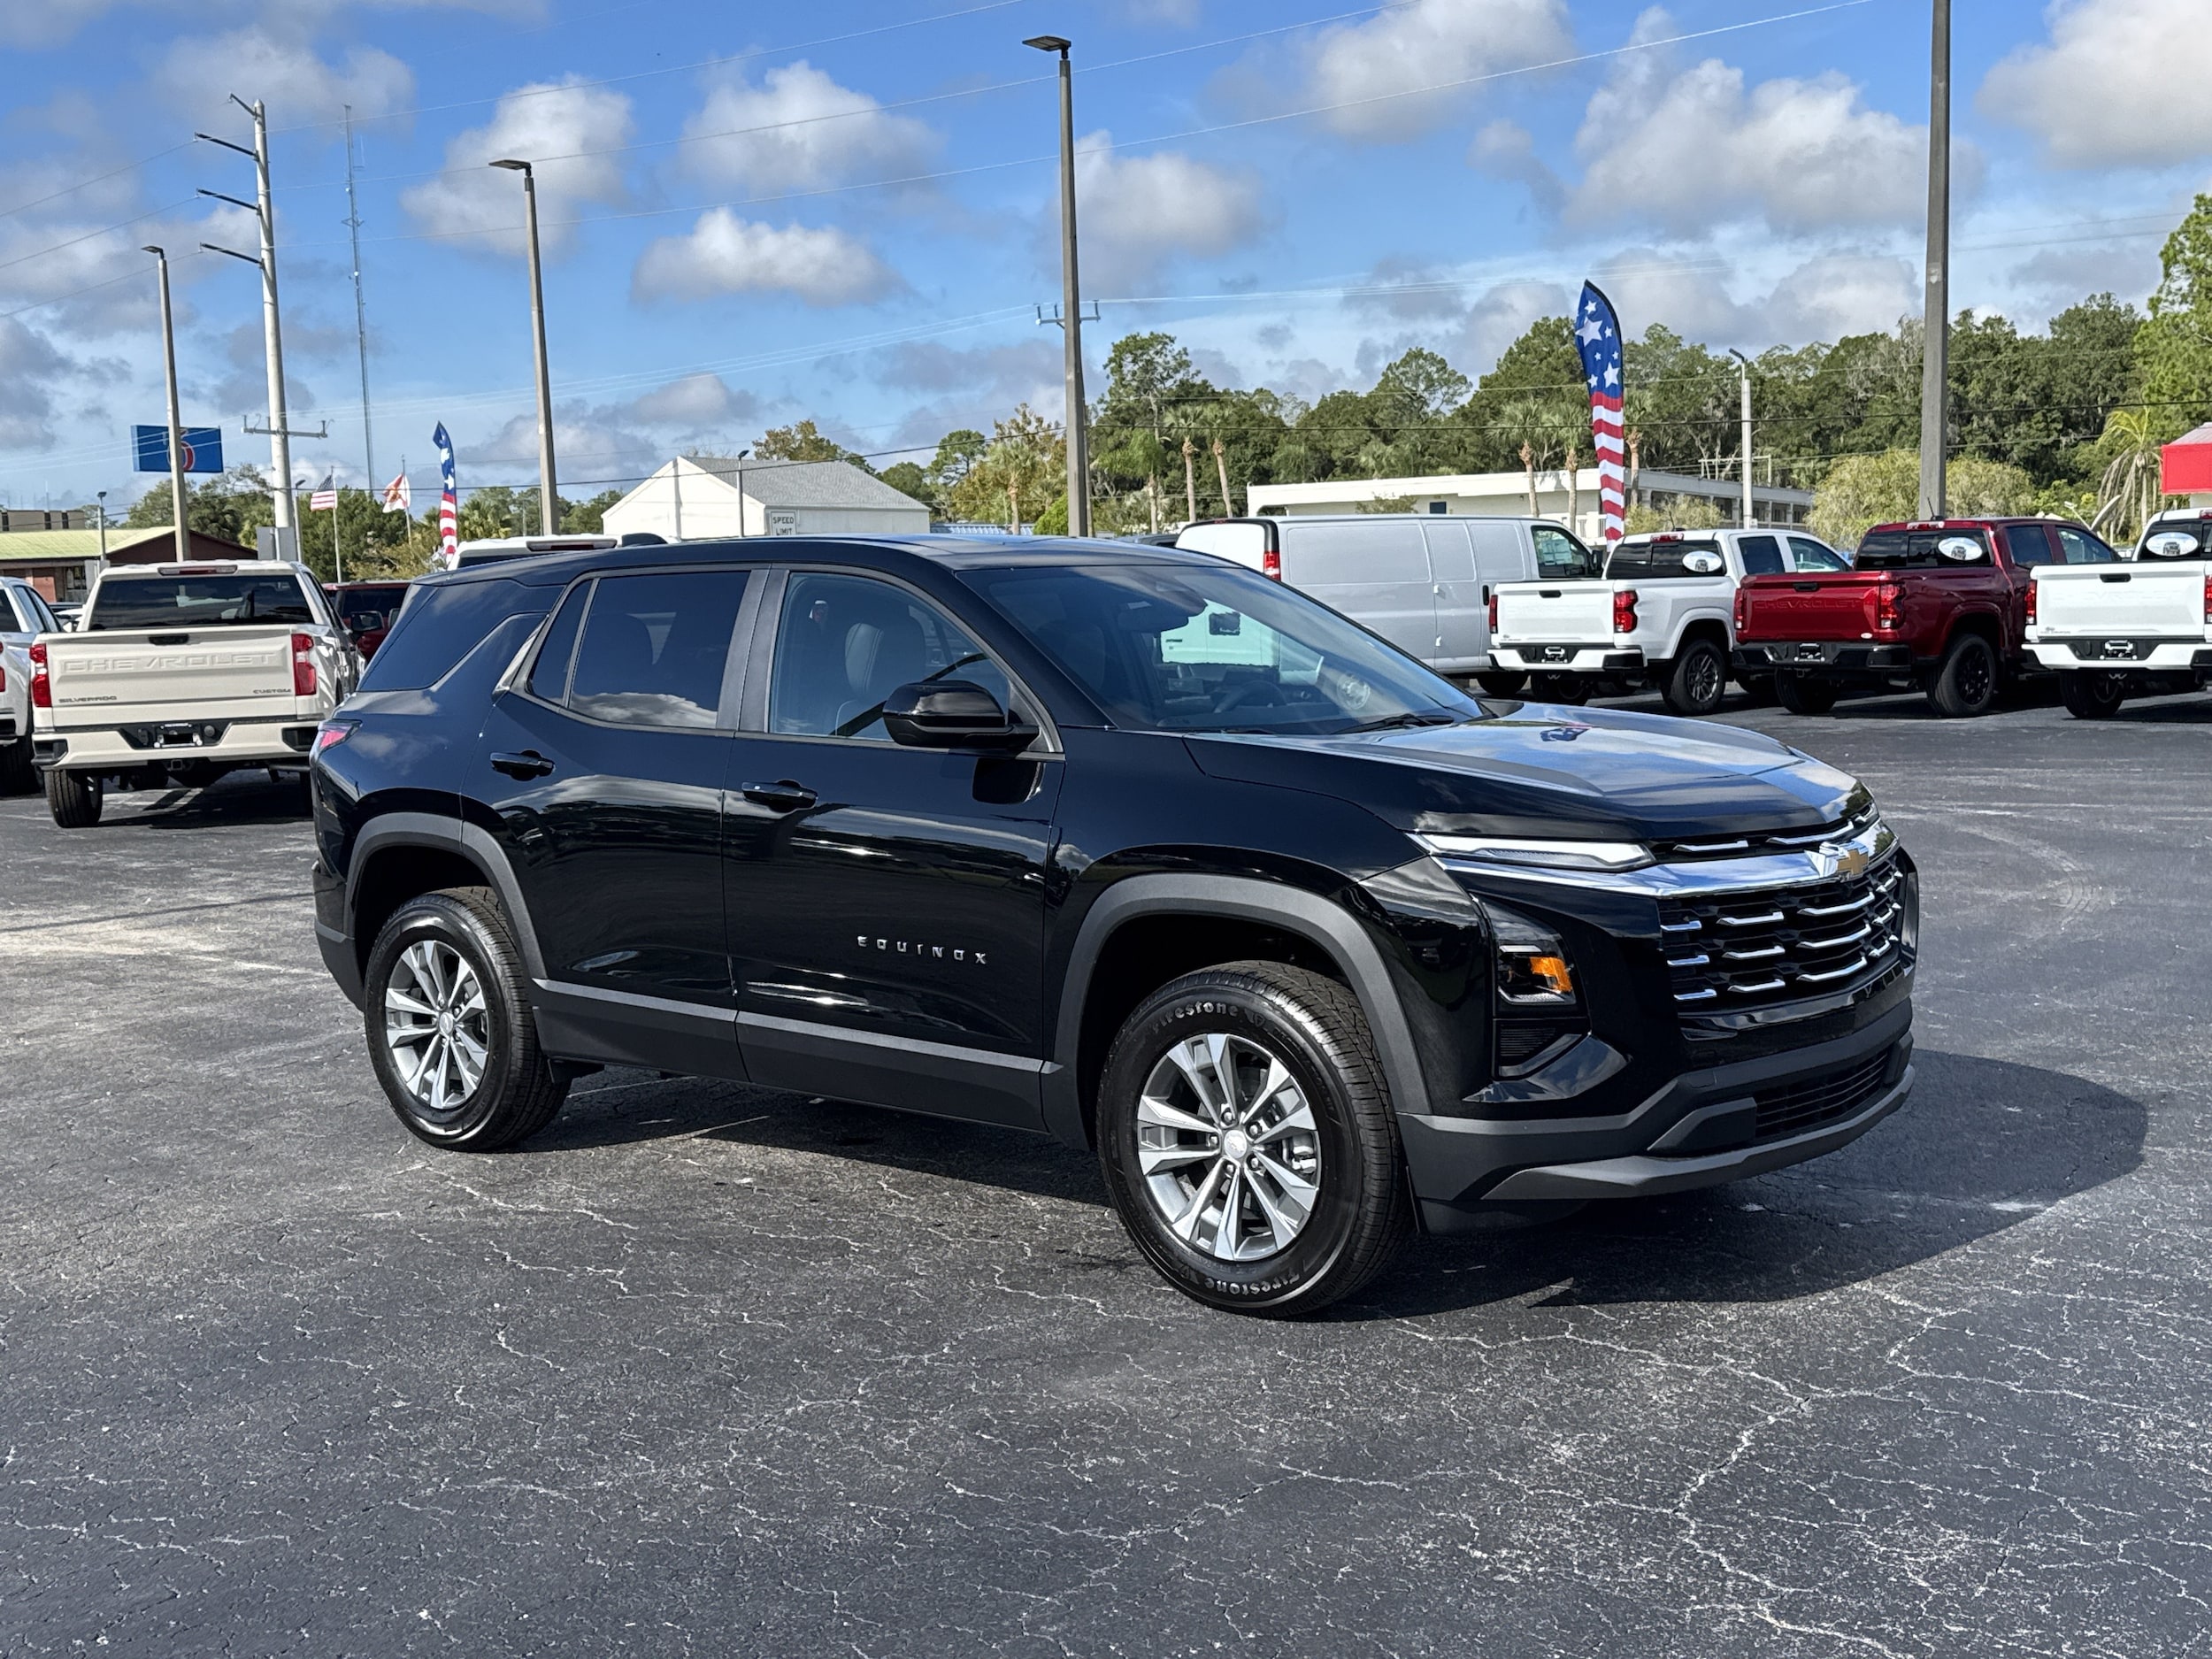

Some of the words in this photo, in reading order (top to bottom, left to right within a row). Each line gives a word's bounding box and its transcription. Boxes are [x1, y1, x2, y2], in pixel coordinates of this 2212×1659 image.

[772, 516, 795, 525] SPEED
[776, 527, 793, 536] LIMIT
[1754, 599, 1862, 610] CHEVROLET
[63, 652, 277, 673] CHEVROLET
[856, 935, 987, 965] EQUINOX
